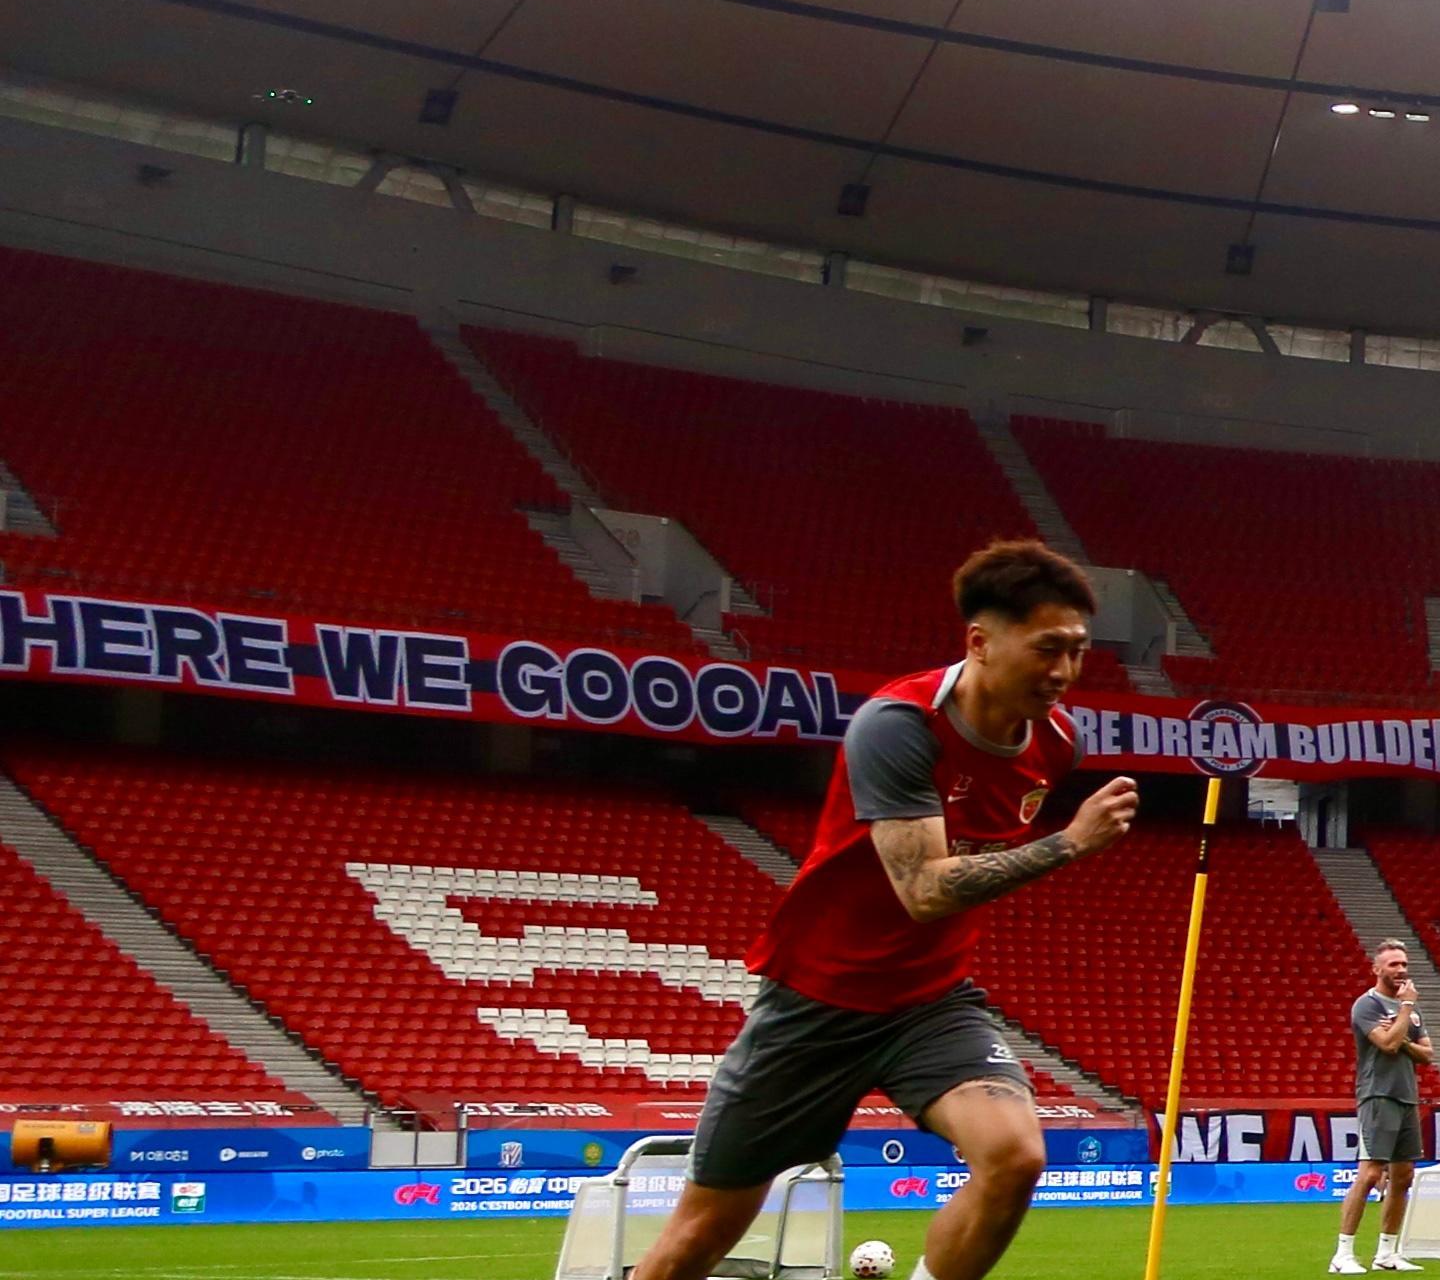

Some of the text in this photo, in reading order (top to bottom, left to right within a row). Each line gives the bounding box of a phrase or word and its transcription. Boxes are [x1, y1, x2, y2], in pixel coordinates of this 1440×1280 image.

[0, 590, 295, 696] HERE
[314, 623, 472, 712] WE
[1062, 705, 1121, 756] RE
[1132, 713, 1278, 759] DREAM
[450, 1177, 507, 1195] 2026
[936, 1172, 971, 1187] 202
[0, 1182, 161, 1202] 足球超级联赛
[1040, 1191, 1081, 1200] FOOTBALL
[1082, 1191, 1108, 1199] SUPER
[1110, 1190, 1142, 1199] LEAGUE
[451, 1201, 477, 1211] 2026
[479, 1200, 531, 1210] C'ESTBON
[632, 1198, 666, 1208] SUPER
[0, 1207, 160, 1219] FOOTBALL SUPER LEAGUE
